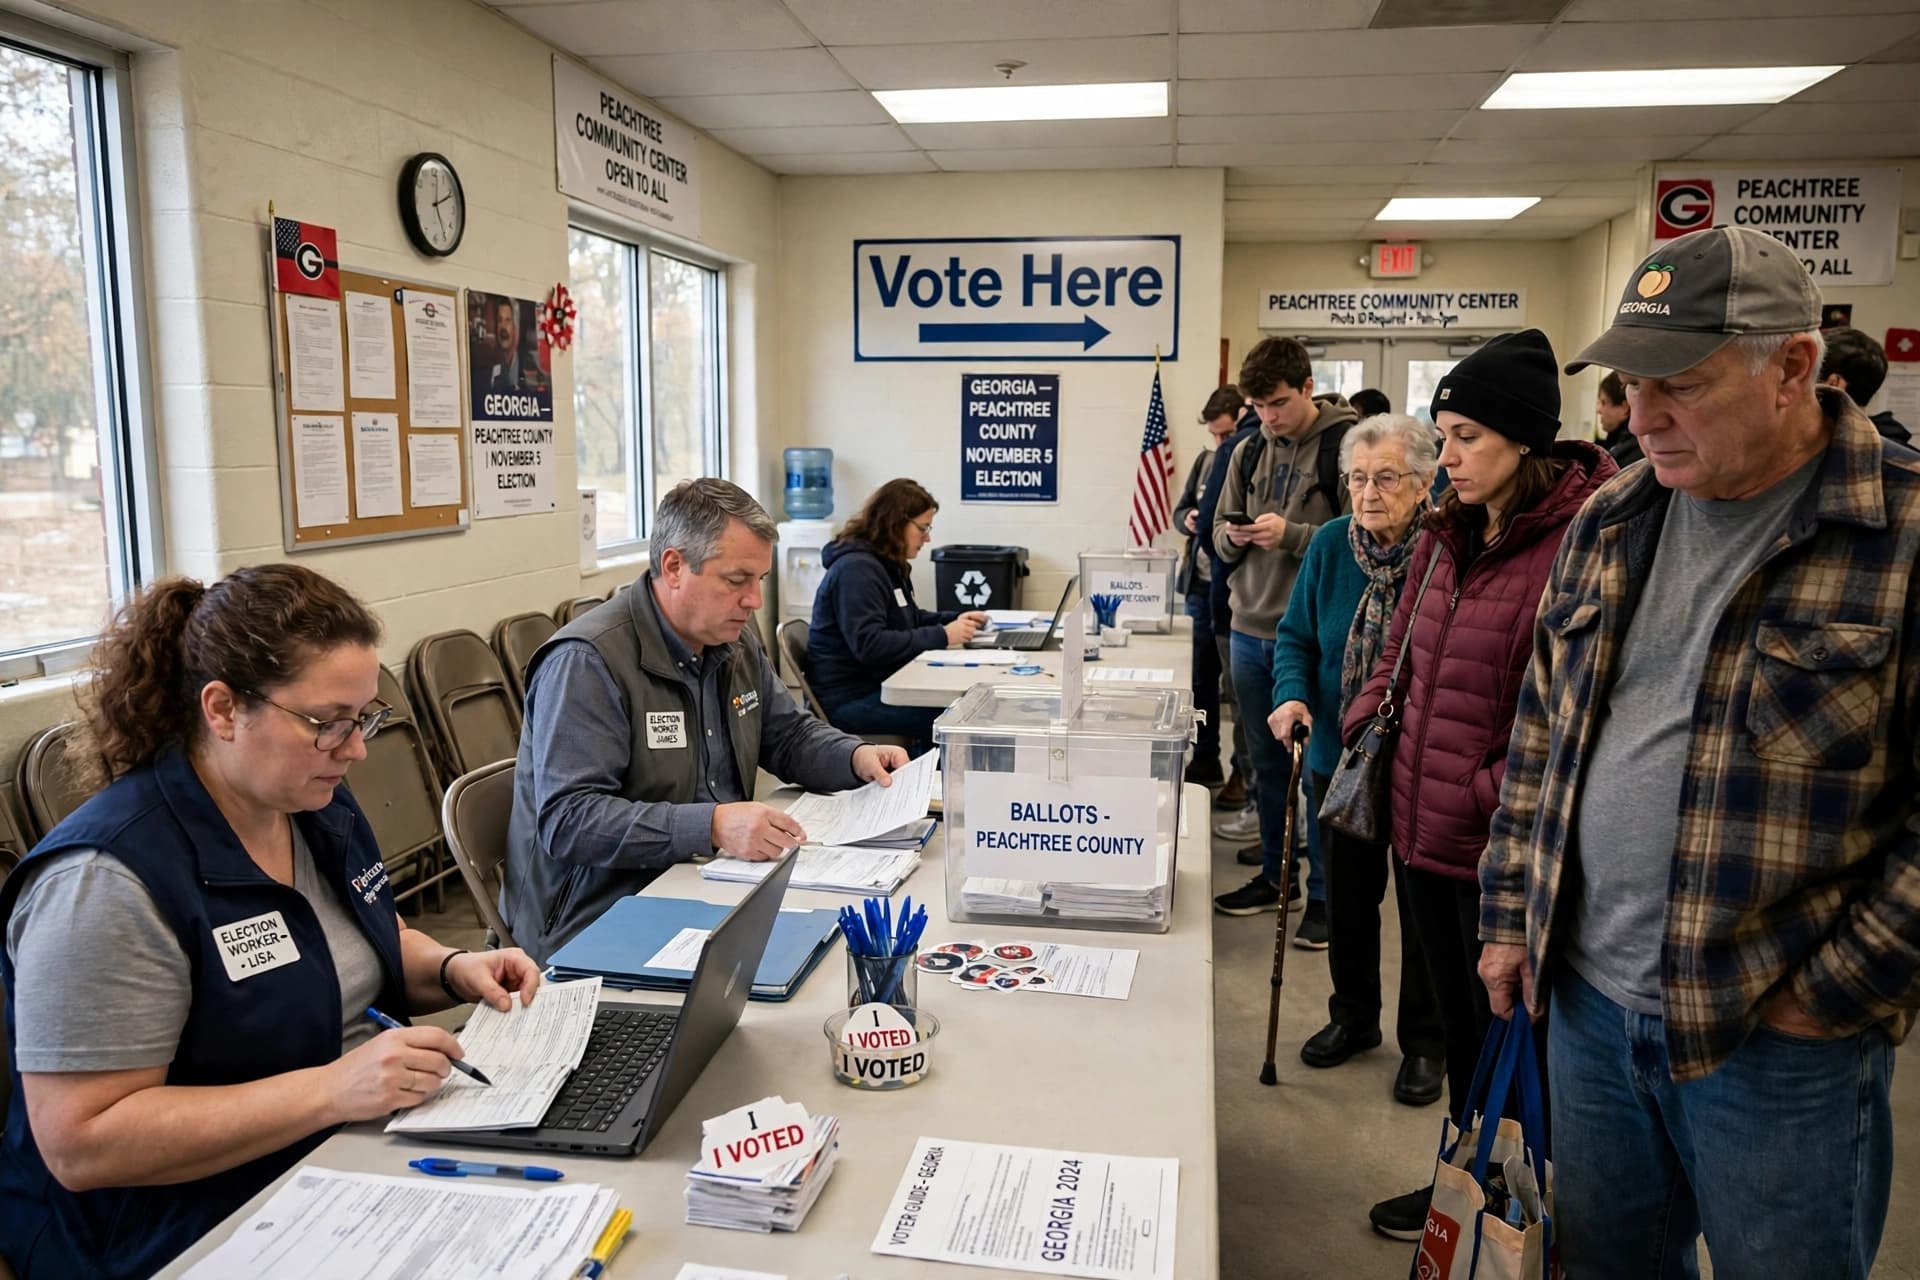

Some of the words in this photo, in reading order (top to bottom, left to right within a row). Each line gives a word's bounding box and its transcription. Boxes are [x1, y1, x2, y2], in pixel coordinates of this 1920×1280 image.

[600, 91, 662, 144] PEACHTREE
[576, 112, 647, 165] COMMUNITY
[650, 149, 688, 184] CENTER
[605, 158, 634, 189] OPEN
[635, 171, 649, 194] TO
[651, 179, 669, 203] ALL
[1737, 178, 1861, 199] PEACHTREE
[1658, 184, 1712, 229] G
[1734, 204, 1866, 225] COMMUNITY
[1761, 230, 1840, 249] ENTER
[1379, 246, 1416, 273] EXIT
[1820, 258, 1852, 275] ALL
[868, 254, 1003, 308] Vote
[1021, 253, 1164, 307] Here
[1269, 295, 1356, 310] PEACHTREE
[1360, 294, 1453, 310] COMMUNITY
[1458, 293, 1519, 309] CENTER
[970, 379, 1037, 395] GEORGIA
[969, 401, 1051, 417] PEACHTREE
[475, 428, 521, 444] PEACHTREE
[523, 428, 553, 444] COUNTY
[979, 423, 1037, 440] COUNTY
[491, 451, 535, 467] NOVEMBER
[536, 451, 542, 465] 5
[966, 447, 1041, 464] NOVEMBER
[1044, 449, 1053, 464] 5
[497, 473, 536, 489] ELECTION
[975, 470, 1042, 486] ELECTION
[1110, 581, 1143, 590] BALLOTS
[650, 715, 680, 724] ELECTION
[652, 725, 678, 733] WORKER
[656, 735, 678, 743] JAMES
[1010, 802, 1098, 825] BALLOTS
[976, 830, 1073, 852] PEACHTREE
[1076, 835, 1145, 855] COUNTY
[221, 918, 278, 944] ELECTION
[247, 951, 276, 969] LISA
[872, 1010, 880, 1027] I
[857, 1029, 911, 1049] VOTED
[843, 1054, 849, 1073] I
[855, 1052, 925, 1079] VOTED
[748, 1111, 758, 1131] I
[713, 1147, 722, 1169] I
[726, 1124, 805, 1163] VOTED
[1056, 1159, 1083, 1192] 2024
[888, 1213, 918, 1245] VOTER
[904, 1185, 929, 1212] GUIDE
[1041, 1196, 1076, 1262] GEORGIA
